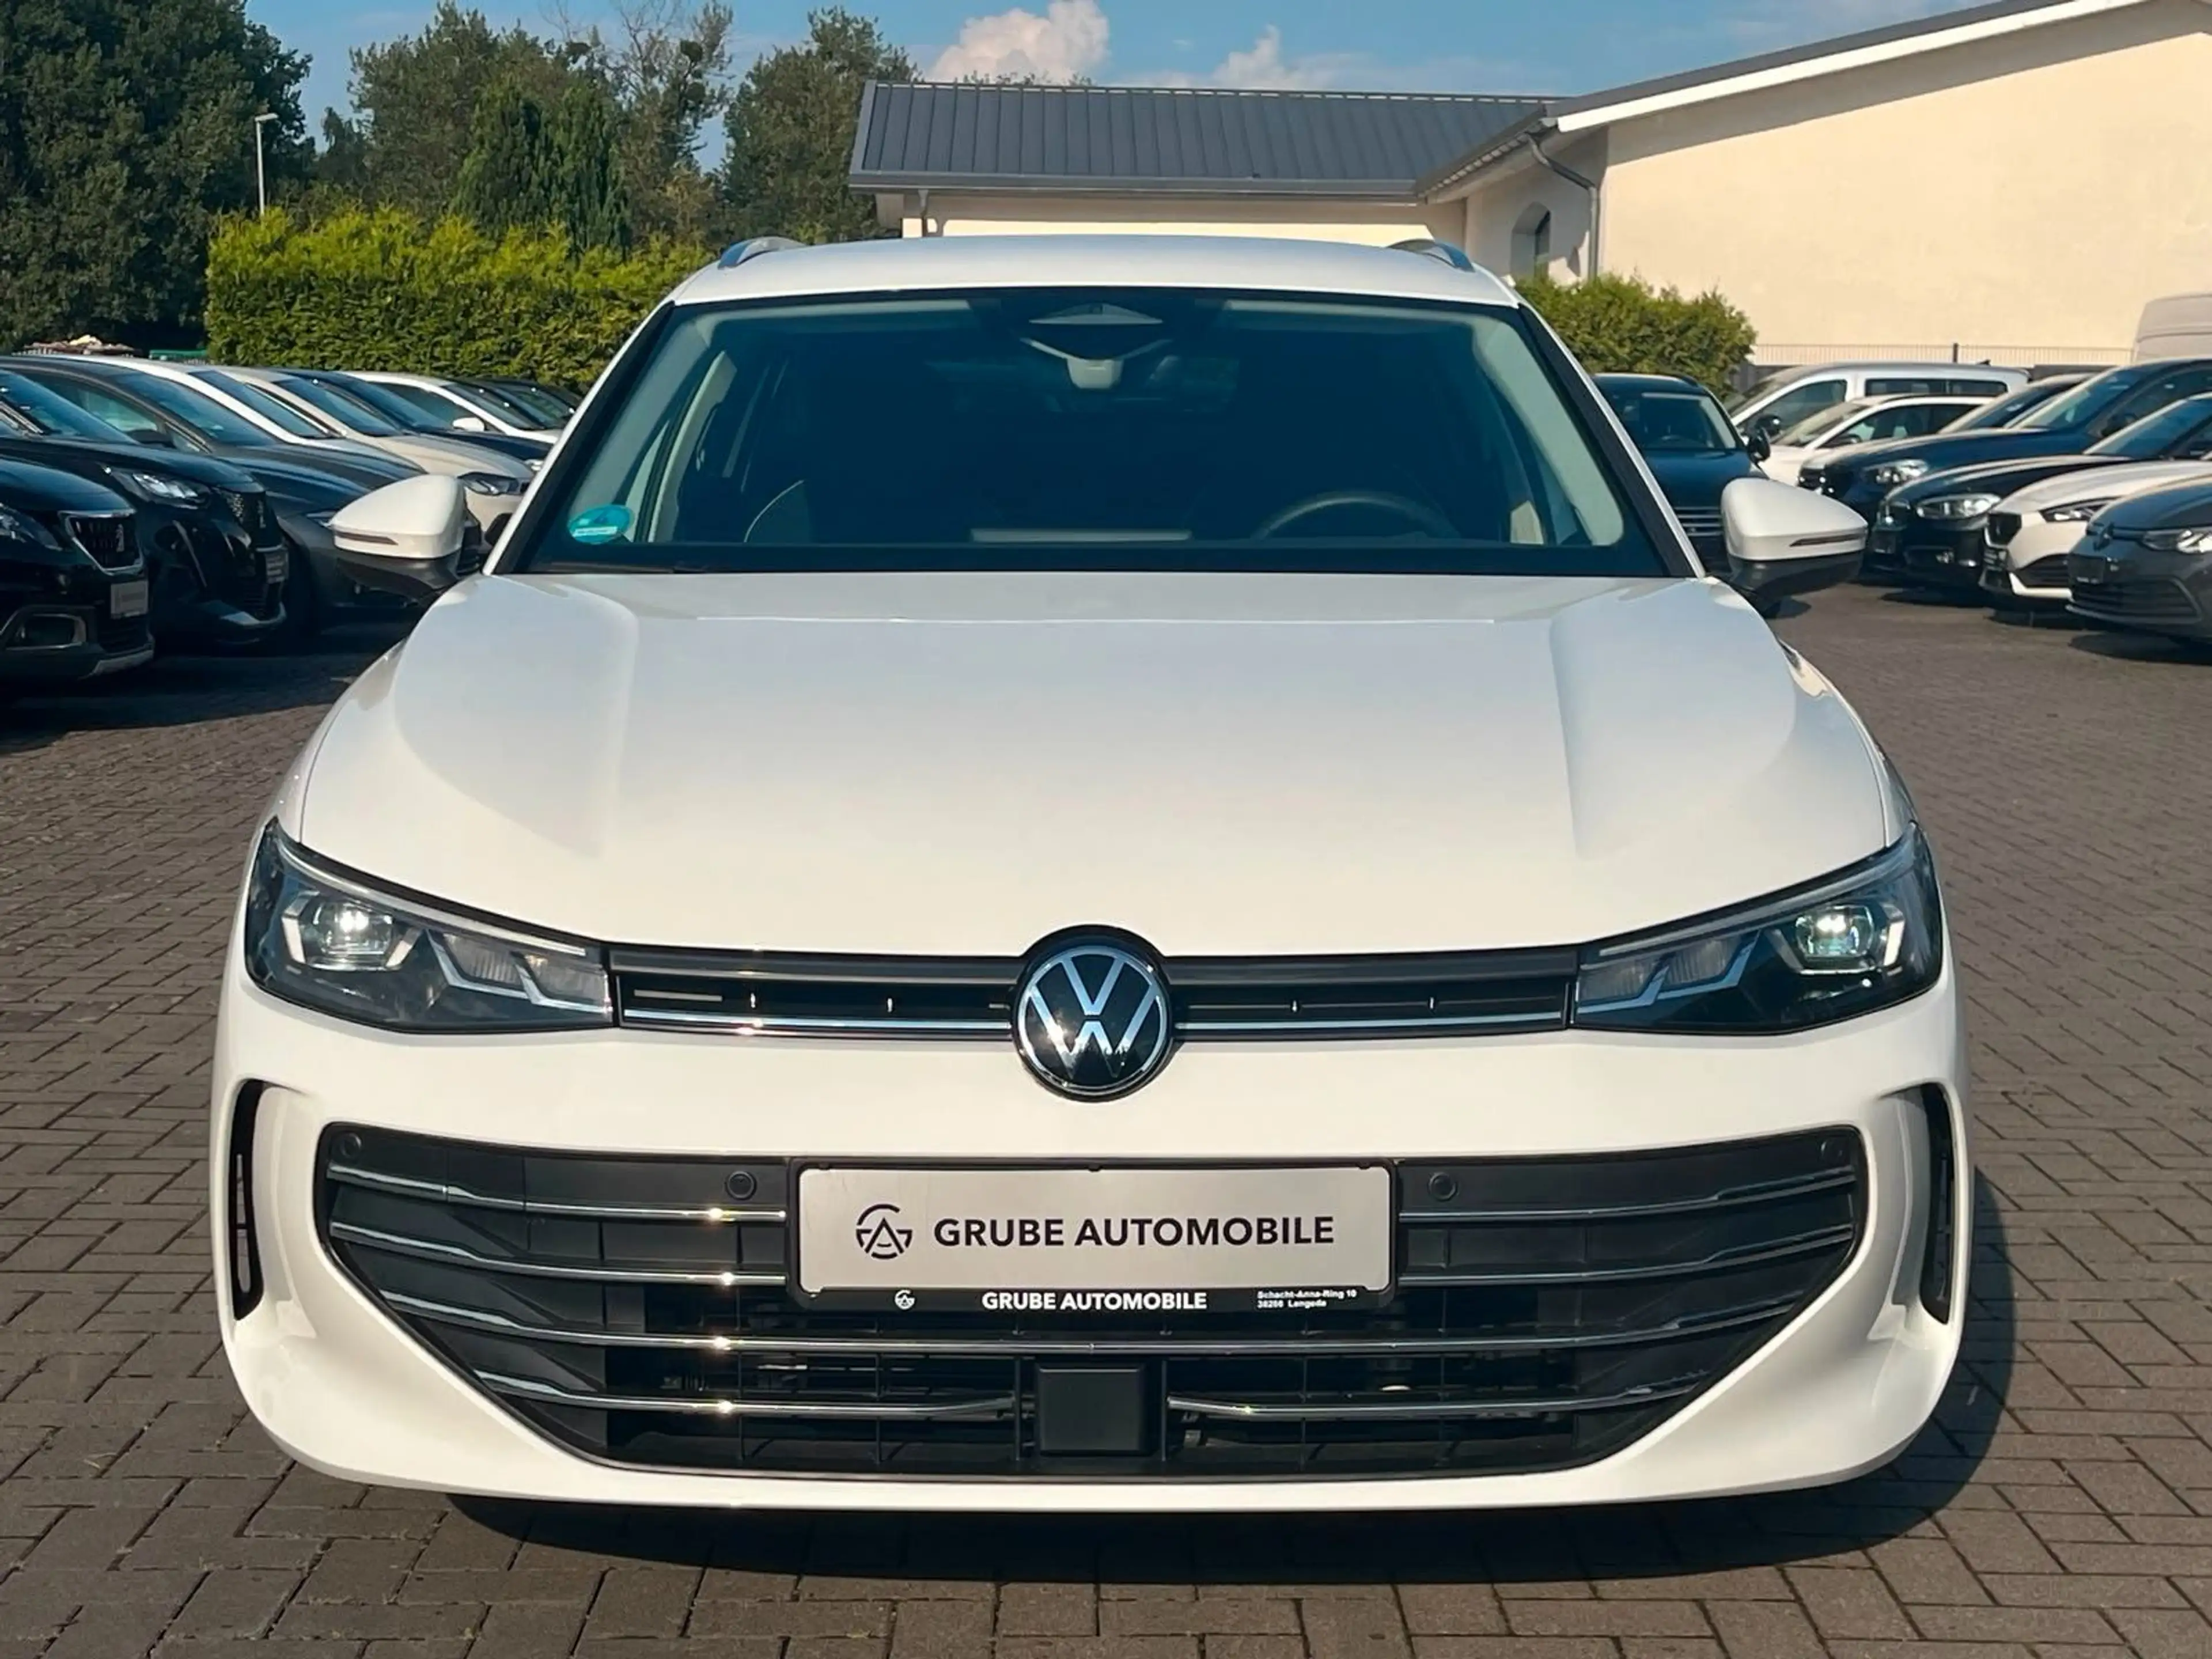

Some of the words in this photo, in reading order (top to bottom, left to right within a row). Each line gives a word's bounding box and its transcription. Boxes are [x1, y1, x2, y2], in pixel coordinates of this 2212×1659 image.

[1028, 950, 1157, 1081] VW
[934, 1218, 1065, 1247] GRUBE
[1074, 1216, 1335, 1247] AUTOMOBILE
[982, 1291, 1056, 1310] GRUBE
[1060, 1292, 1207, 1310] AUTOMOBILE
